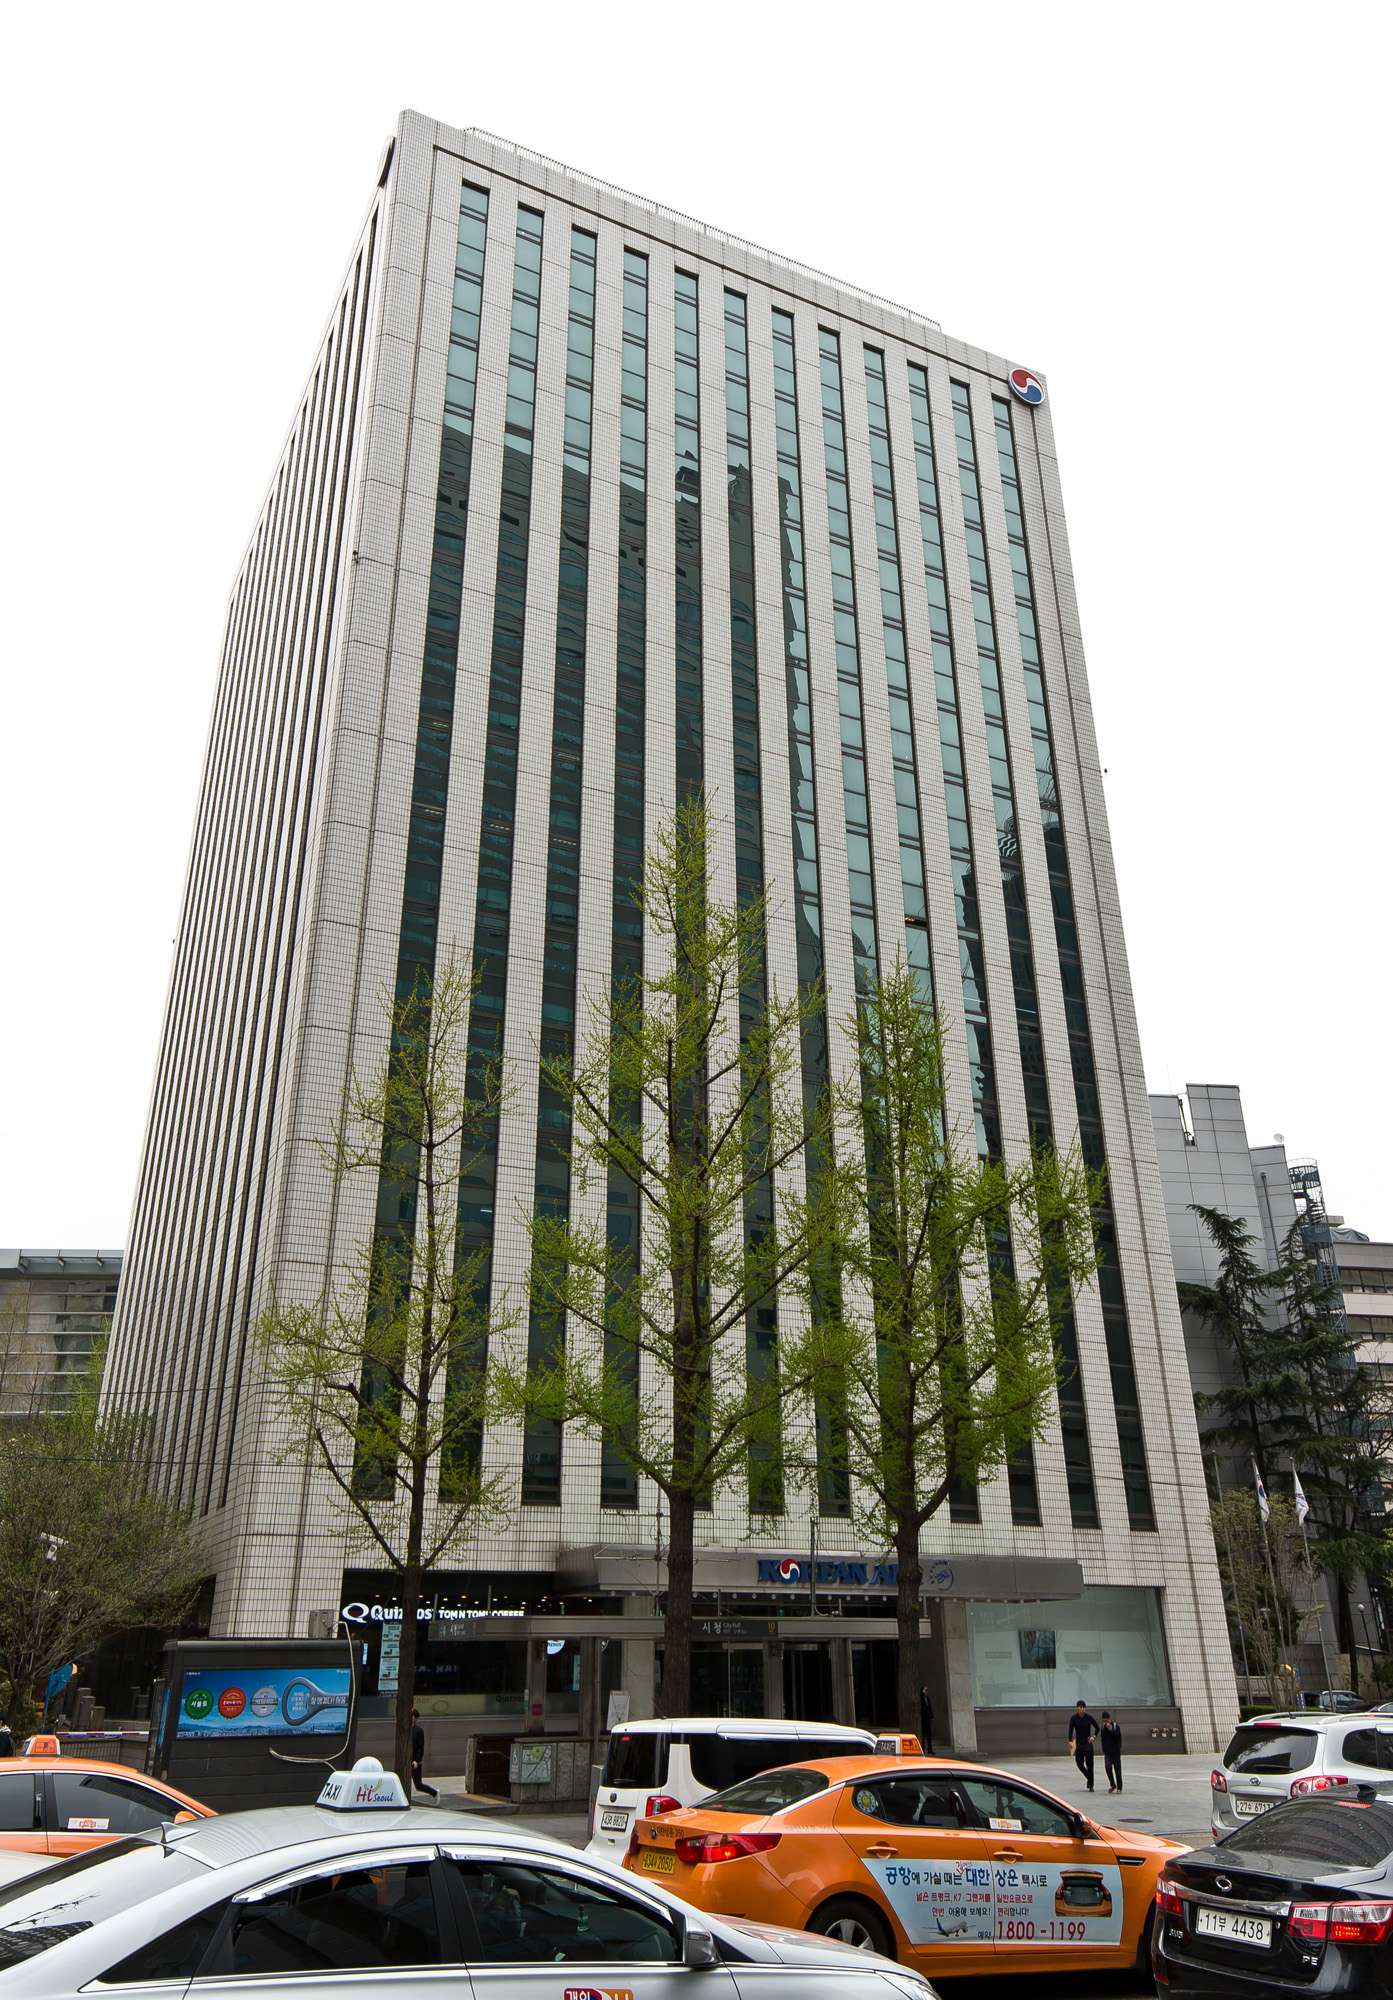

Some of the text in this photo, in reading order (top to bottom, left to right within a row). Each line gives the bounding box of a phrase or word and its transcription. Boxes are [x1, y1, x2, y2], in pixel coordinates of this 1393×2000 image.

[757, 1558, 869, 1585] KOREAN
[438, 1609, 457, 1619] TOM
[458, 1609, 465, 1619] N
[702, 1621, 721, 1634] 시청
[767, 1622, 776, 1630] 10
[322, 1783, 342, 1801] TAXI
[356, 1784, 374, 1802] Hi
[675, 1828, 685, 1839] 250
[657, 1855, 674, 1872] 2050
[885, 1866, 1048, 1888] 공항에 가실 때는 대한 상운 택시로
[916, 1891, 929, 1902] 넓은
[931, 1892, 953, 1903] 트렁크,
[996, 1893, 1033, 1904] 일반요금으로
[931, 1906, 1030, 1917] 한번 이용해 보세요! 편리합니다!
[1204, 1912, 1265, 1941] 11부 4438
[977, 1930, 992, 1940] 예약
[1302, 1955, 1319, 1966] PE
